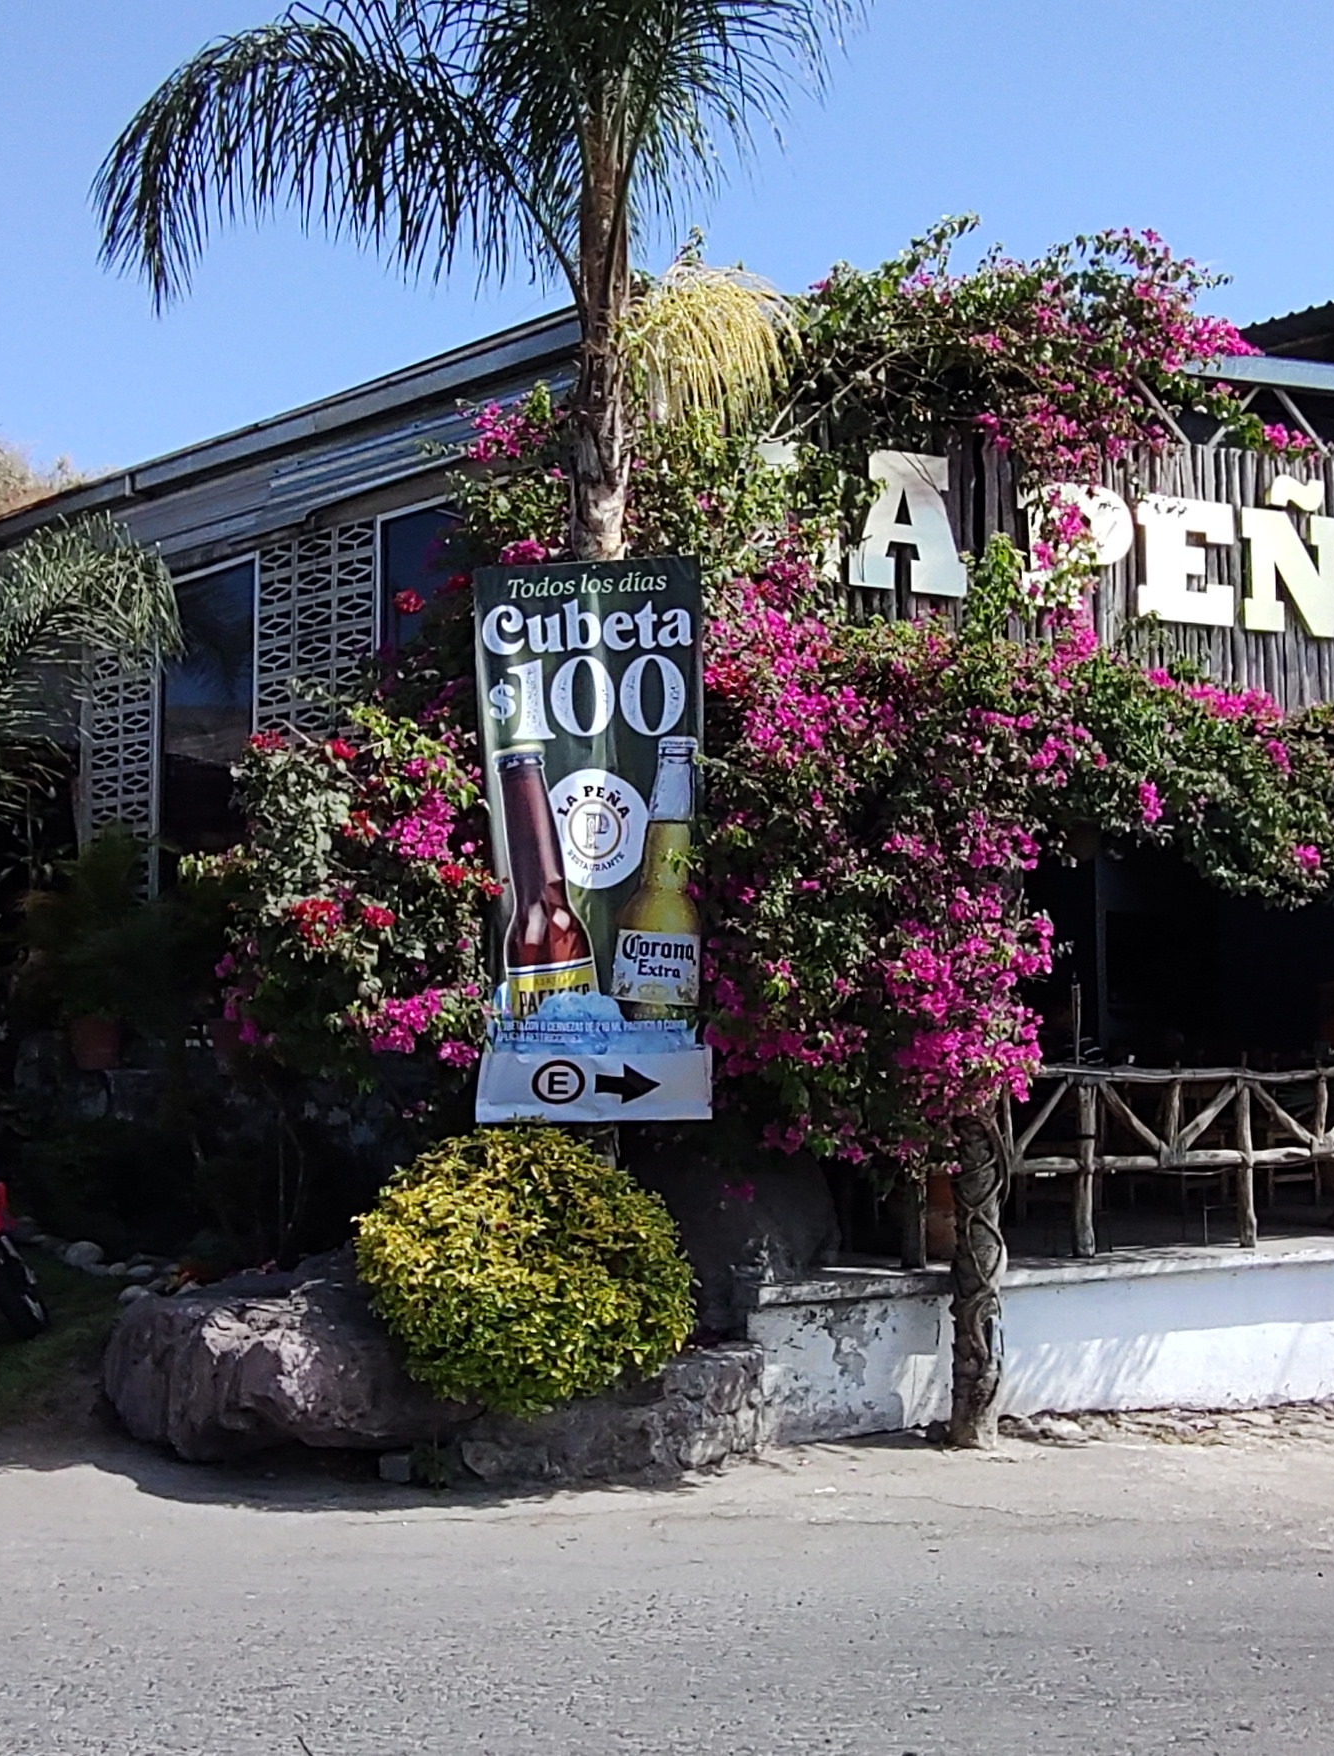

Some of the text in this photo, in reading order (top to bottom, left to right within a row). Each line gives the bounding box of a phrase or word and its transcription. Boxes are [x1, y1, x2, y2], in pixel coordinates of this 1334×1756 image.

[507, 571, 668, 599] Todos los días
[481, 598, 694, 655] Cubeta
[489, 654, 686, 740] $100
[557, 785, 631, 819] LA PEÑA
[567, 848, 626, 872] RESTAURANTE
[622, 933, 697, 967] Corona
[637, 959, 682, 979] Extra
[547, 1071, 569, 1095] E
